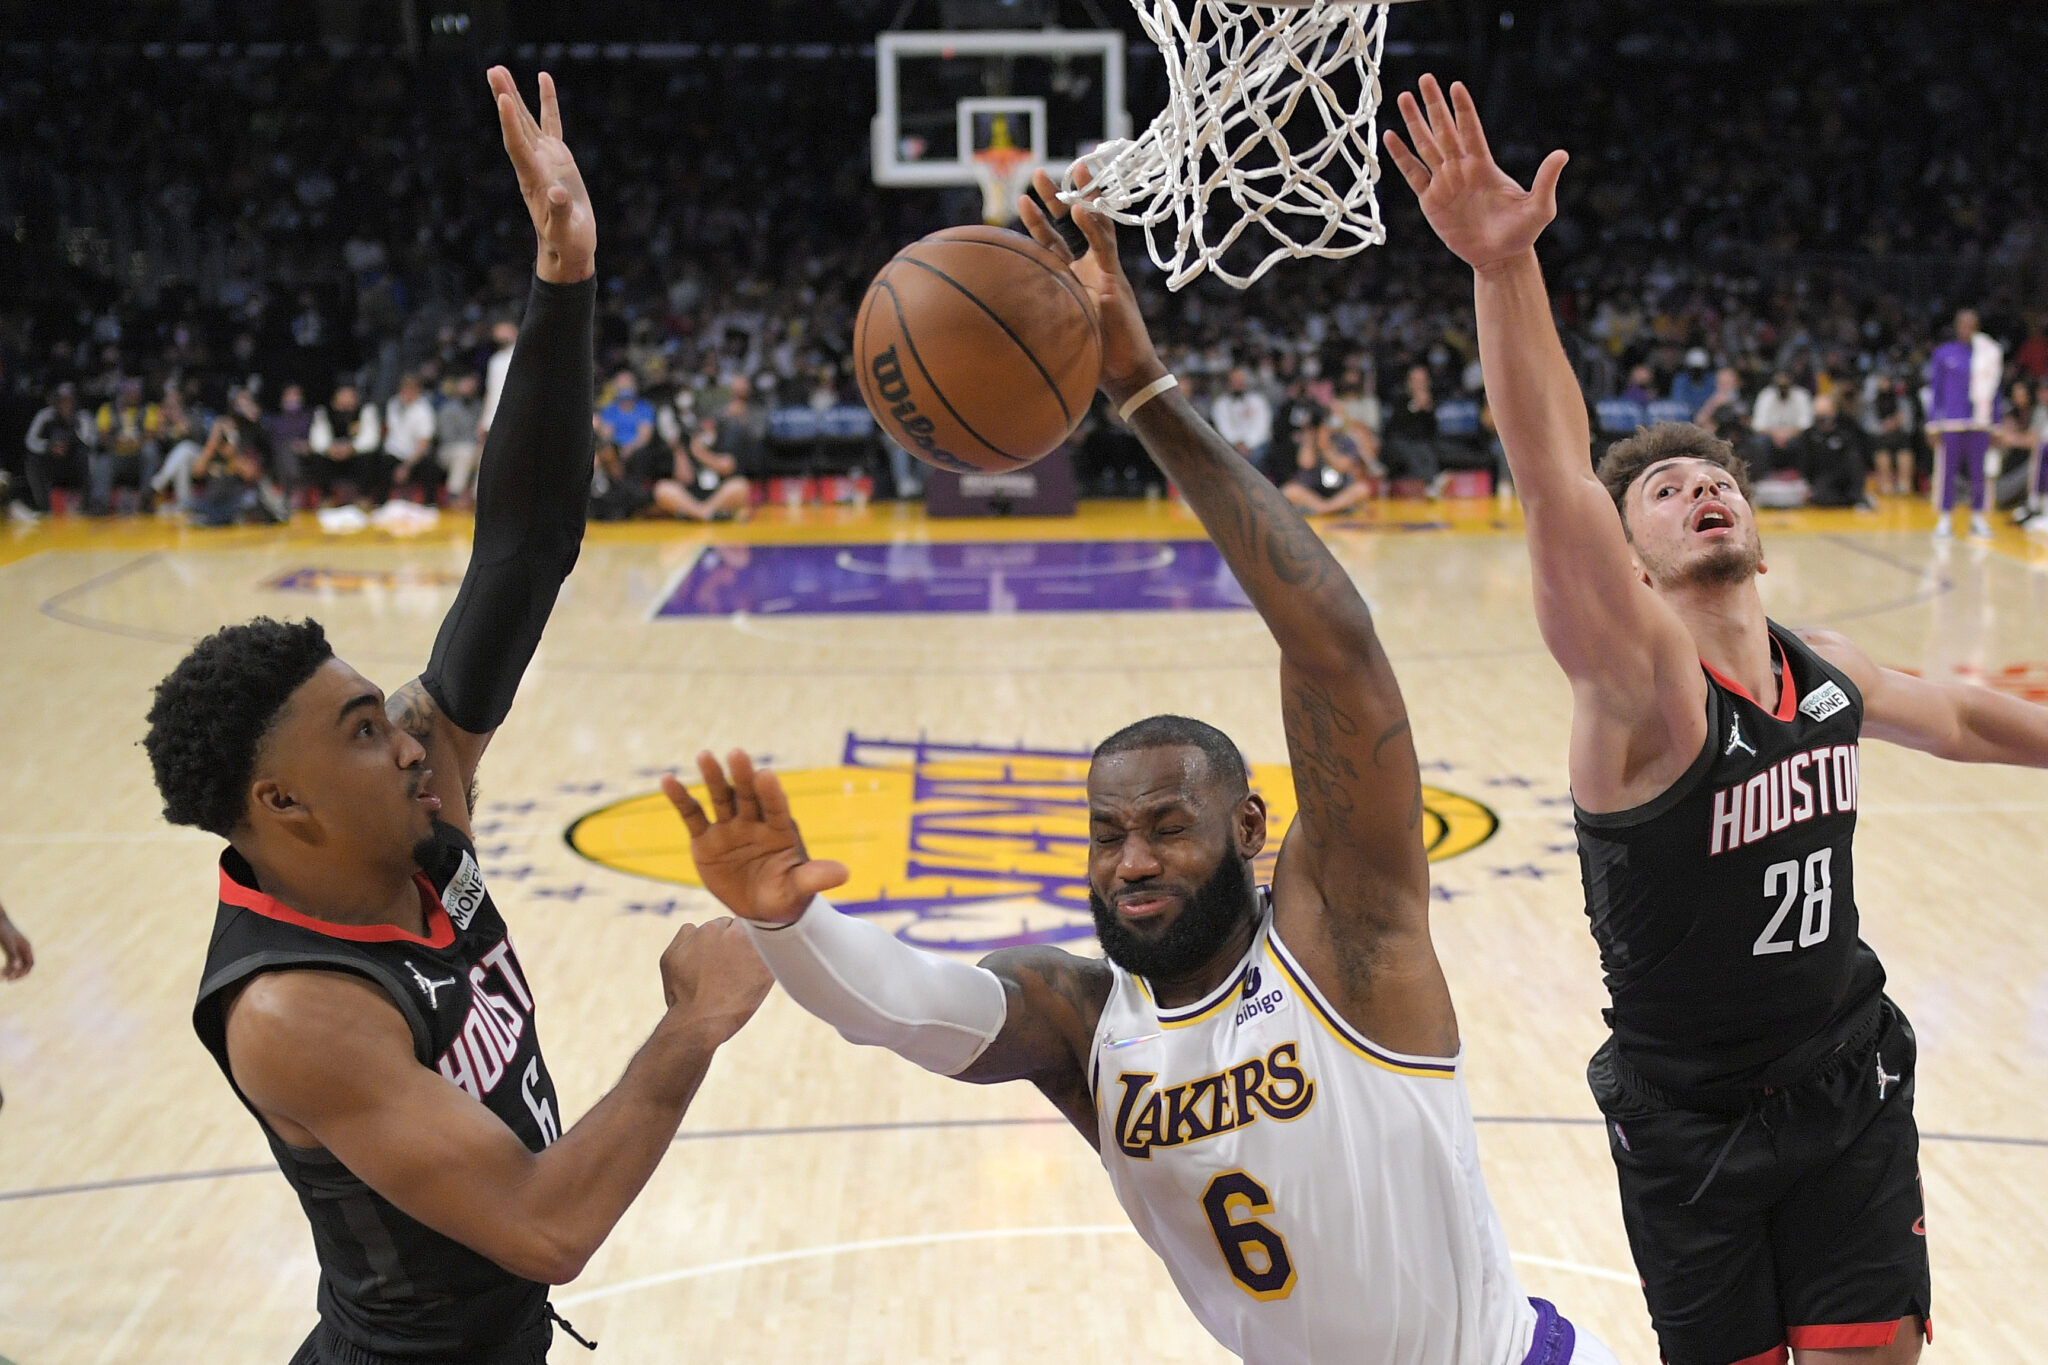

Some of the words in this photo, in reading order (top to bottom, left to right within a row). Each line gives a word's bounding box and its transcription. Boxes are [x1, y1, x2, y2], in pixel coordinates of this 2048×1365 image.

[1810, 692, 1848, 719] MONEY
[1752, 847, 1833, 956] 28
[437, 930, 536, 1102] HOUST
[1236, 989, 1283, 1027] bibigo
[521, 1055, 558, 1148] 6
[1114, 1040, 1317, 1161] LAKERS
[1199, 1167, 1298, 1302] 6
